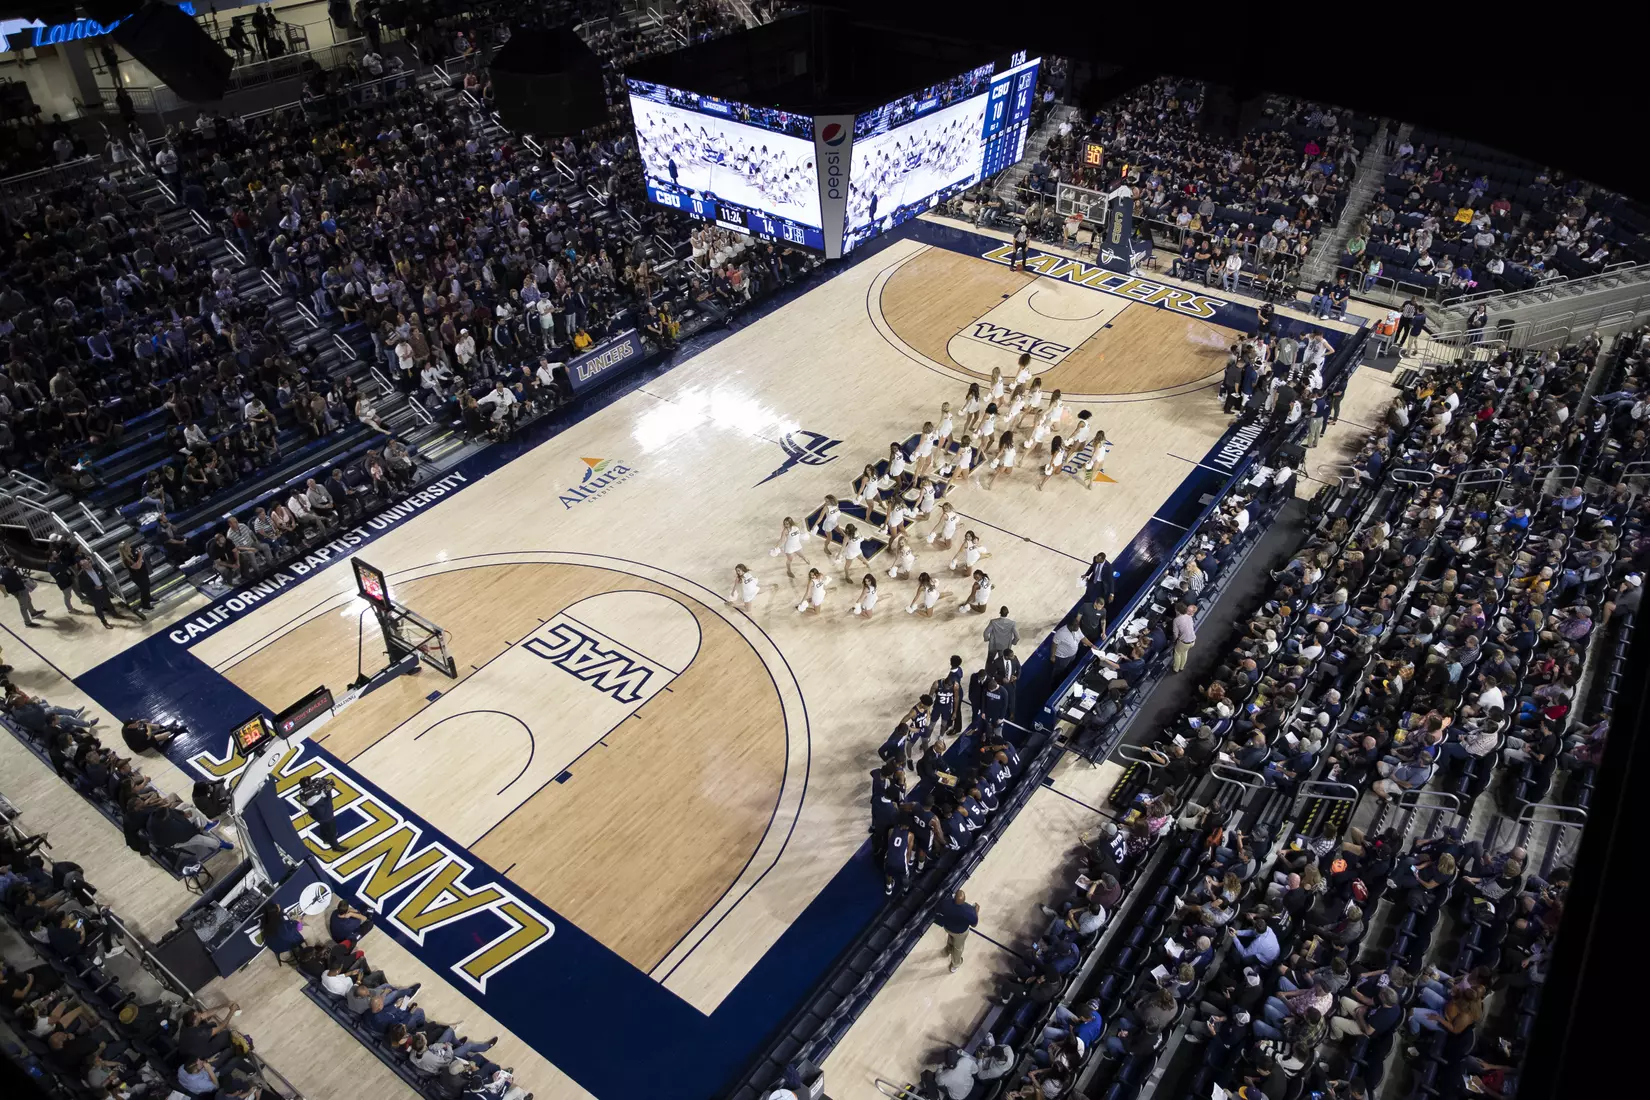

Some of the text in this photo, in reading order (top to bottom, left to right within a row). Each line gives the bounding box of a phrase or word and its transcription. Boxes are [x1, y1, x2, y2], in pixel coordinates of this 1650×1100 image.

[992, 81, 1010, 100] CBU
[1017, 90, 1027, 110] 14
[993, 100, 1003, 121] 10
[1087, 151, 1100, 165] 30
[825, 151, 843, 199] pepsi
[655, 190, 681, 208] CBU
[691, 200, 704, 214] 10
[721, 208, 742, 224] 11:24
[763, 219, 775, 235] 14
[1112, 211, 1124, 244] CBU
[981, 242, 1228, 319] LANCERS
[973, 322, 1071, 360] WAC
[576, 340, 634, 381] LANCERS
[1213, 419, 1265, 469] NIVERSITY
[559, 464, 631, 510] Altura
[588, 470, 640, 504] CREDIT UNION
[169, 571, 296, 645] CALIFORNIA
[289, 526, 371, 577] BAPTIST
[368, 471, 468, 530] UNIVERSITY
[521, 623, 654, 704] WAC
[939, 696, 950, 705] 21
[243, 729, 261, 746] 30
[971, 805, 980, 815] 5
[958, 823, 966, 833] 4
[894, 836, 902, 847] 0
